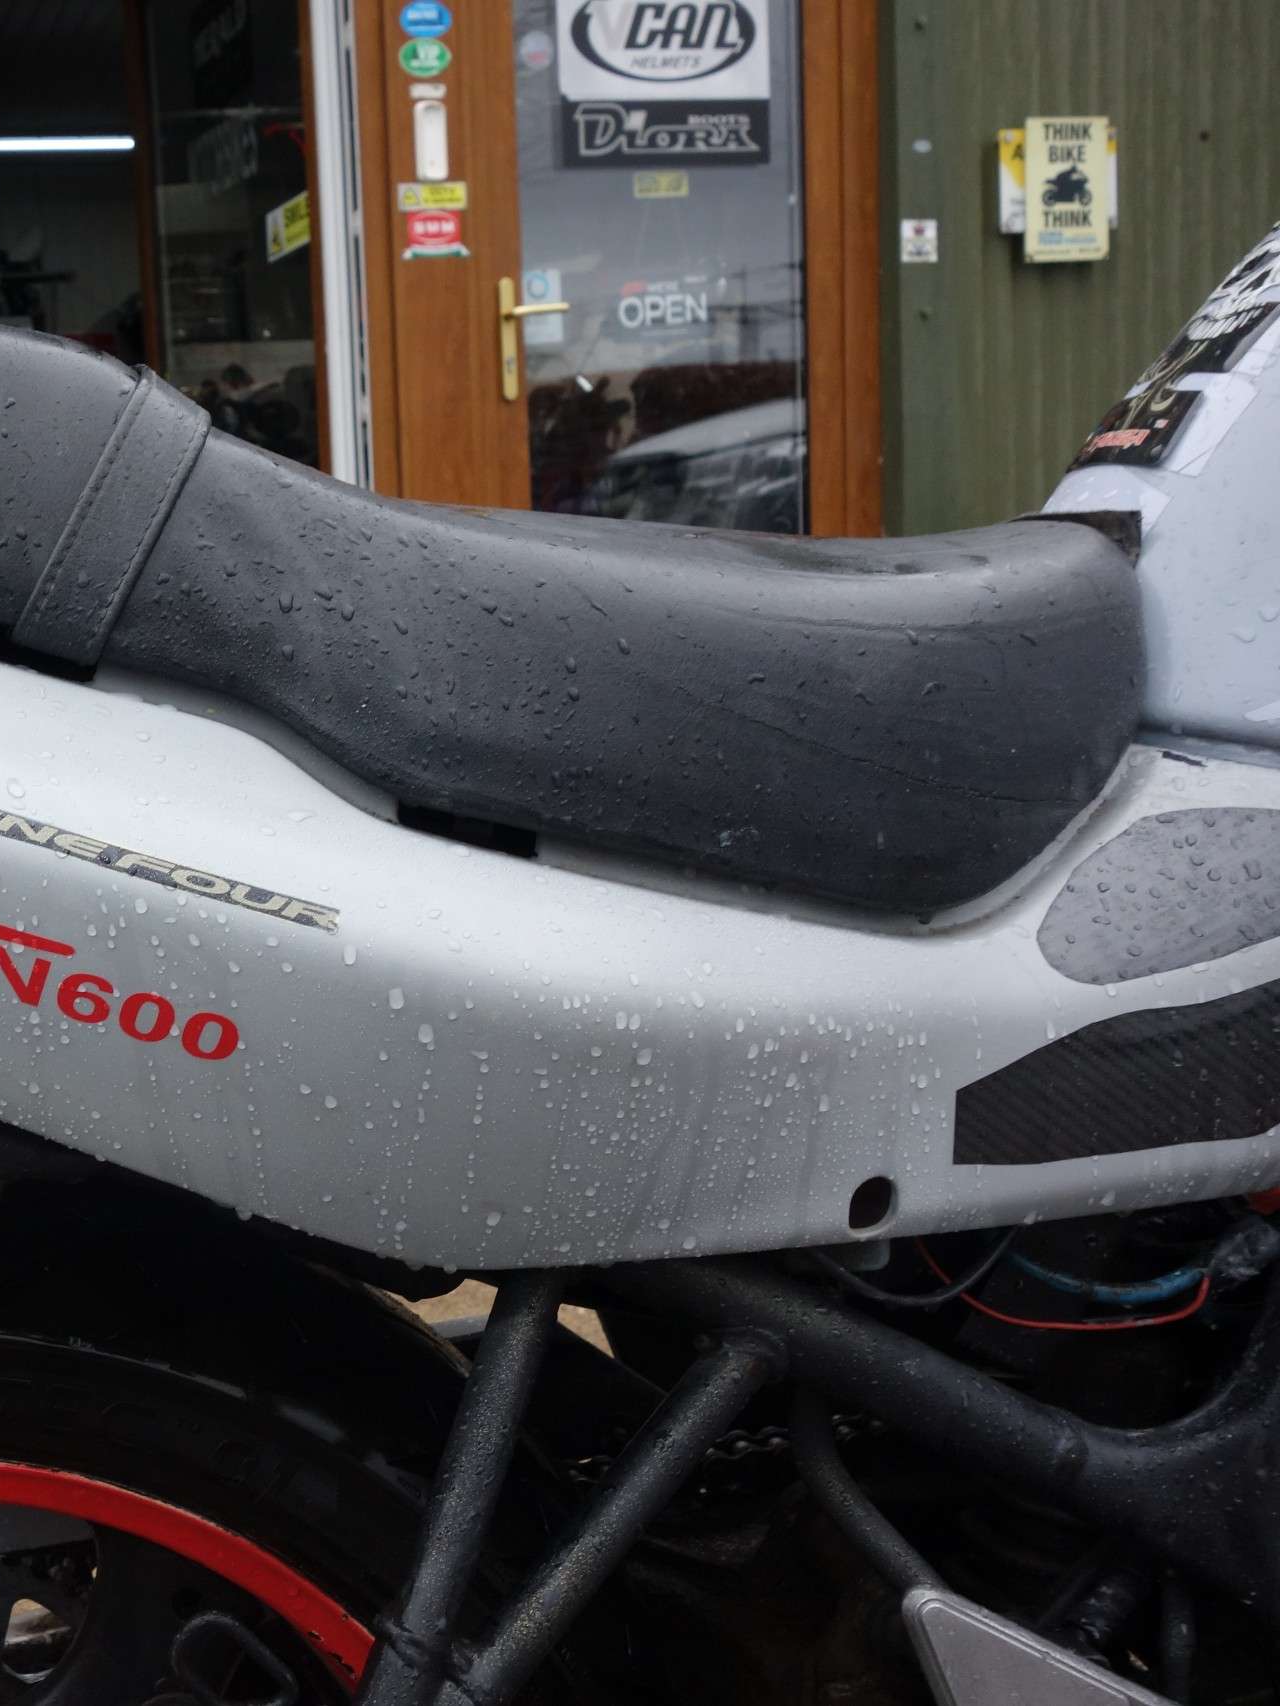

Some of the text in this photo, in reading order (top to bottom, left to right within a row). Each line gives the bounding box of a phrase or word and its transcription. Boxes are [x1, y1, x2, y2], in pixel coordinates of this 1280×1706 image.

[630, 56, 703, 70] HELMETS
[1043, 122, 1092, 141] THINK
[1048, 144, 1086, 163] BIKE
[1043, 209, 1092, 228] THINK
[618, 292, 708, 329] OPEN
[115, 852, 340, 932] FOUR
